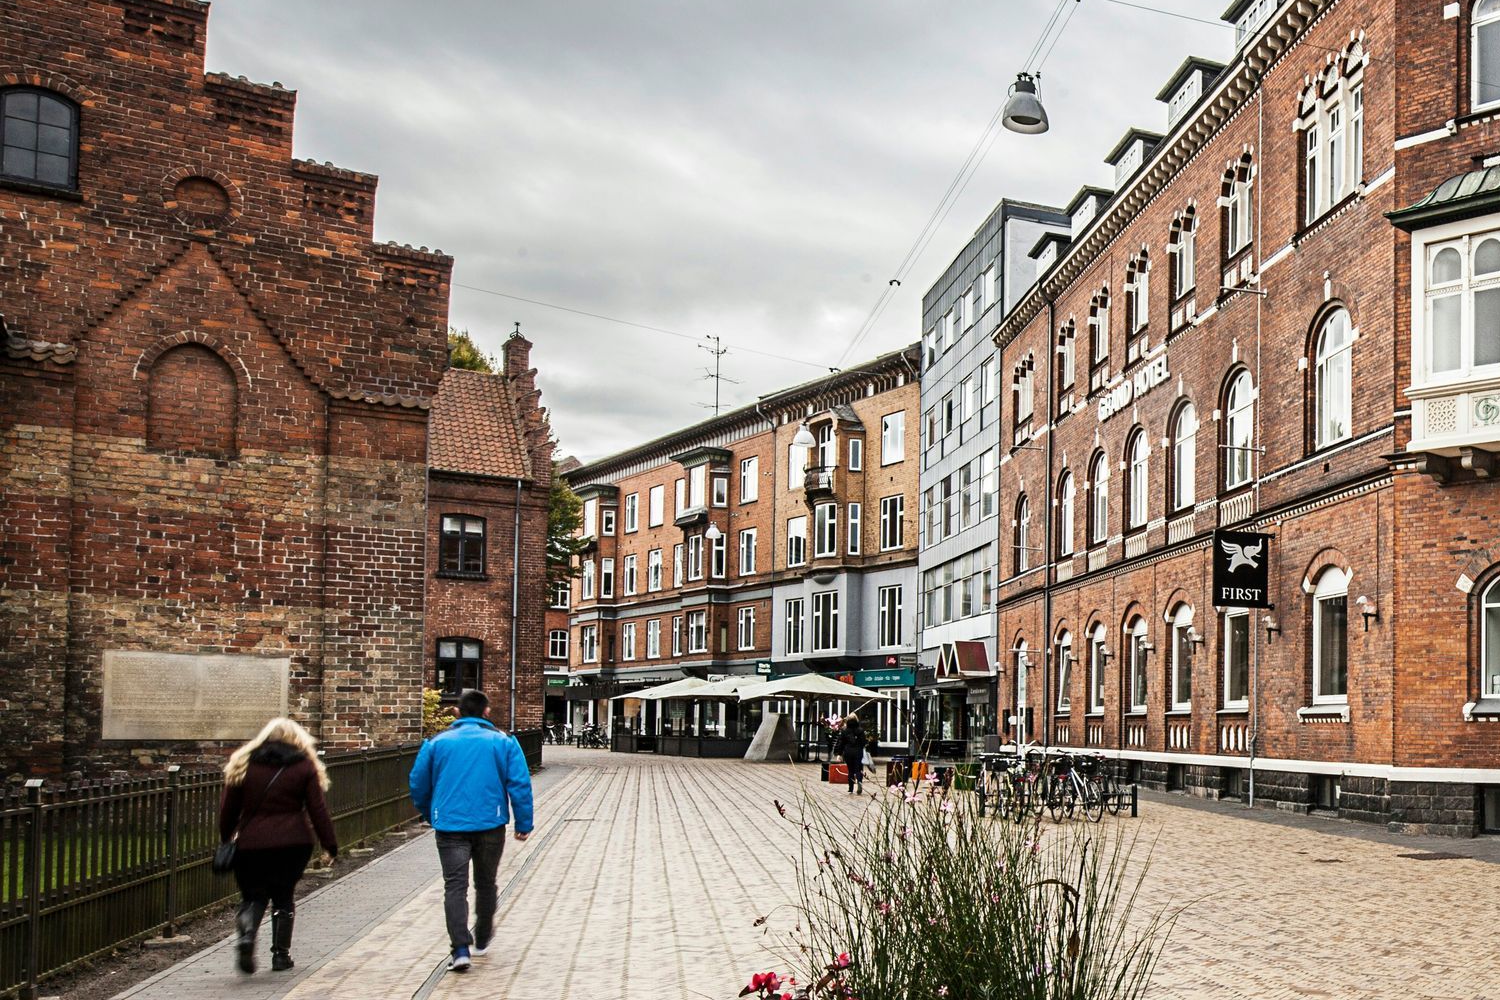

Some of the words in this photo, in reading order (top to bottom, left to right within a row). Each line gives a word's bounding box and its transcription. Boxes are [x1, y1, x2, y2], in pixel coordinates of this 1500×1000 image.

[1098, 380, 1134, 423] GRAND
[1134, 354, 1171, 399] HOTEL
[1221, 586, 1262, 601] FIRST
